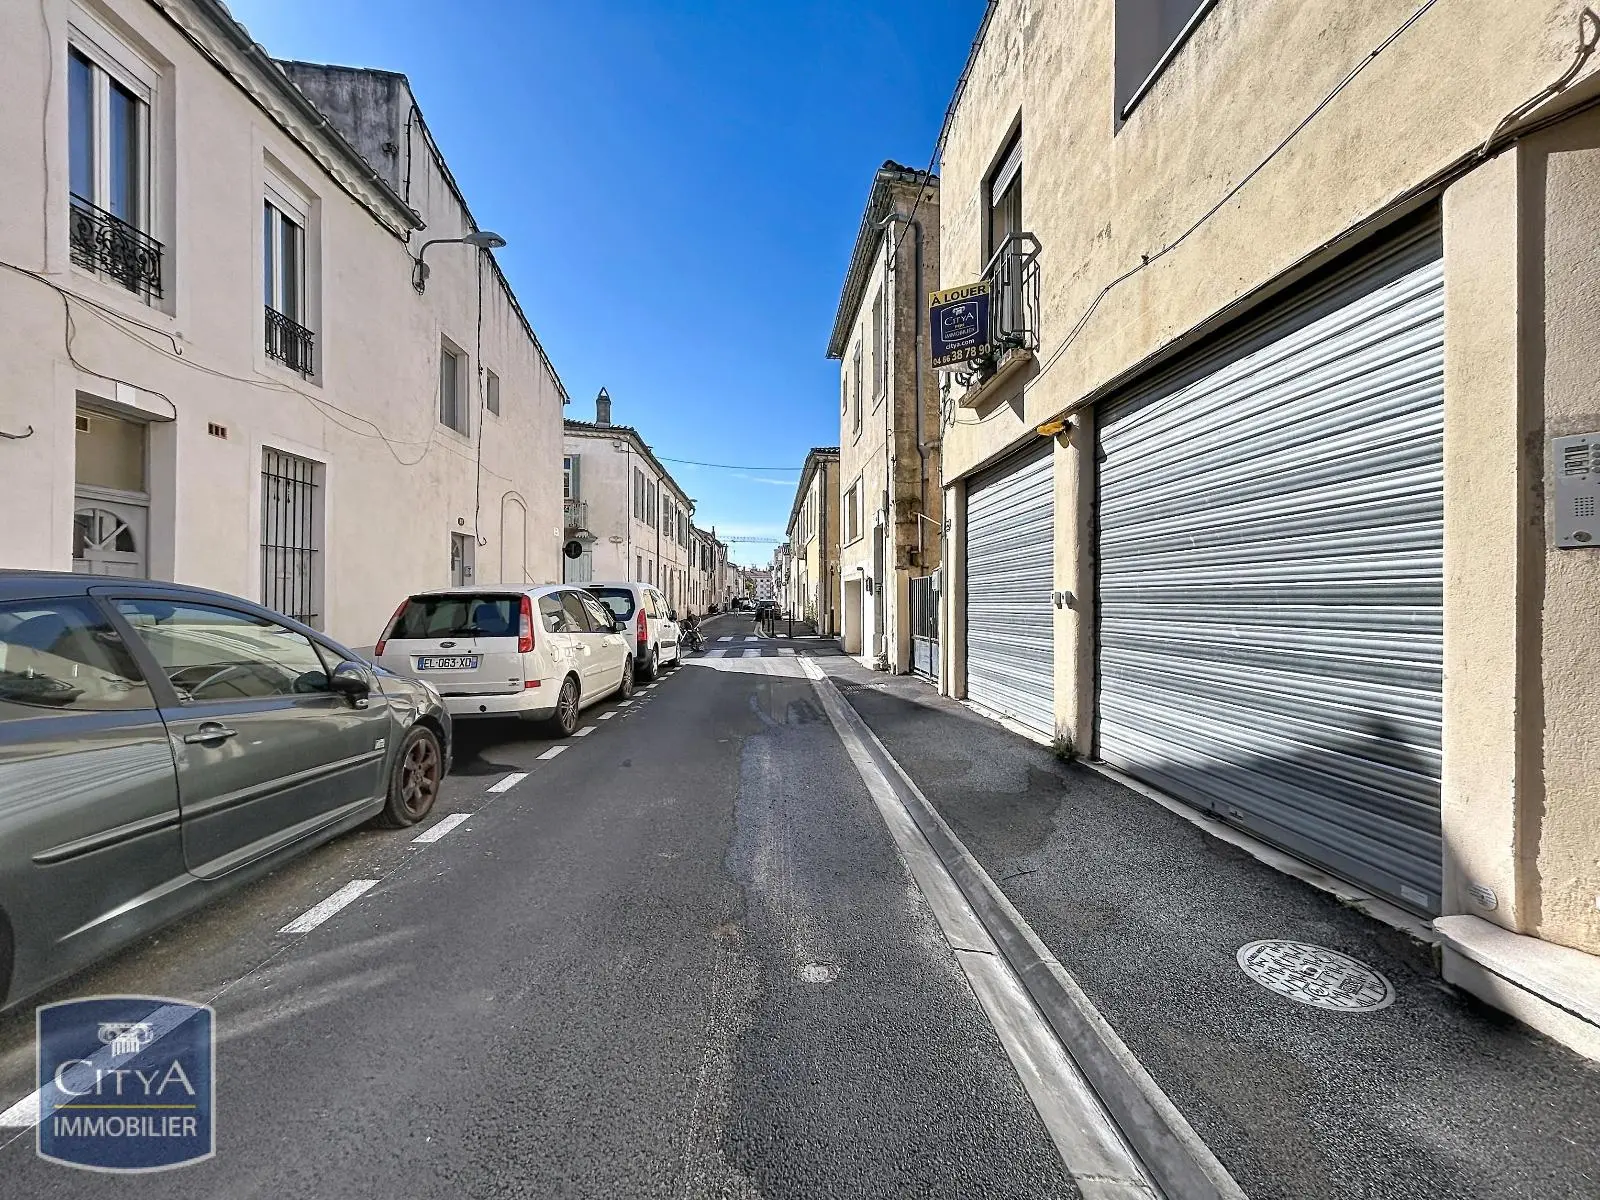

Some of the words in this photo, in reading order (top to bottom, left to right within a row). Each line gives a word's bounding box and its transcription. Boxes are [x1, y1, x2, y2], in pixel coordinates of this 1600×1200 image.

[944, 285, 986, 303] LOUER
[945, 339, 975, 350] citya.com
[933, 357, 941, 366] 04
[942, 354, 951, 363] 66
[951, 349, 963, 361] 38
[965, 346, 977, 358] 78
[978, 343, 991, 355] 90
